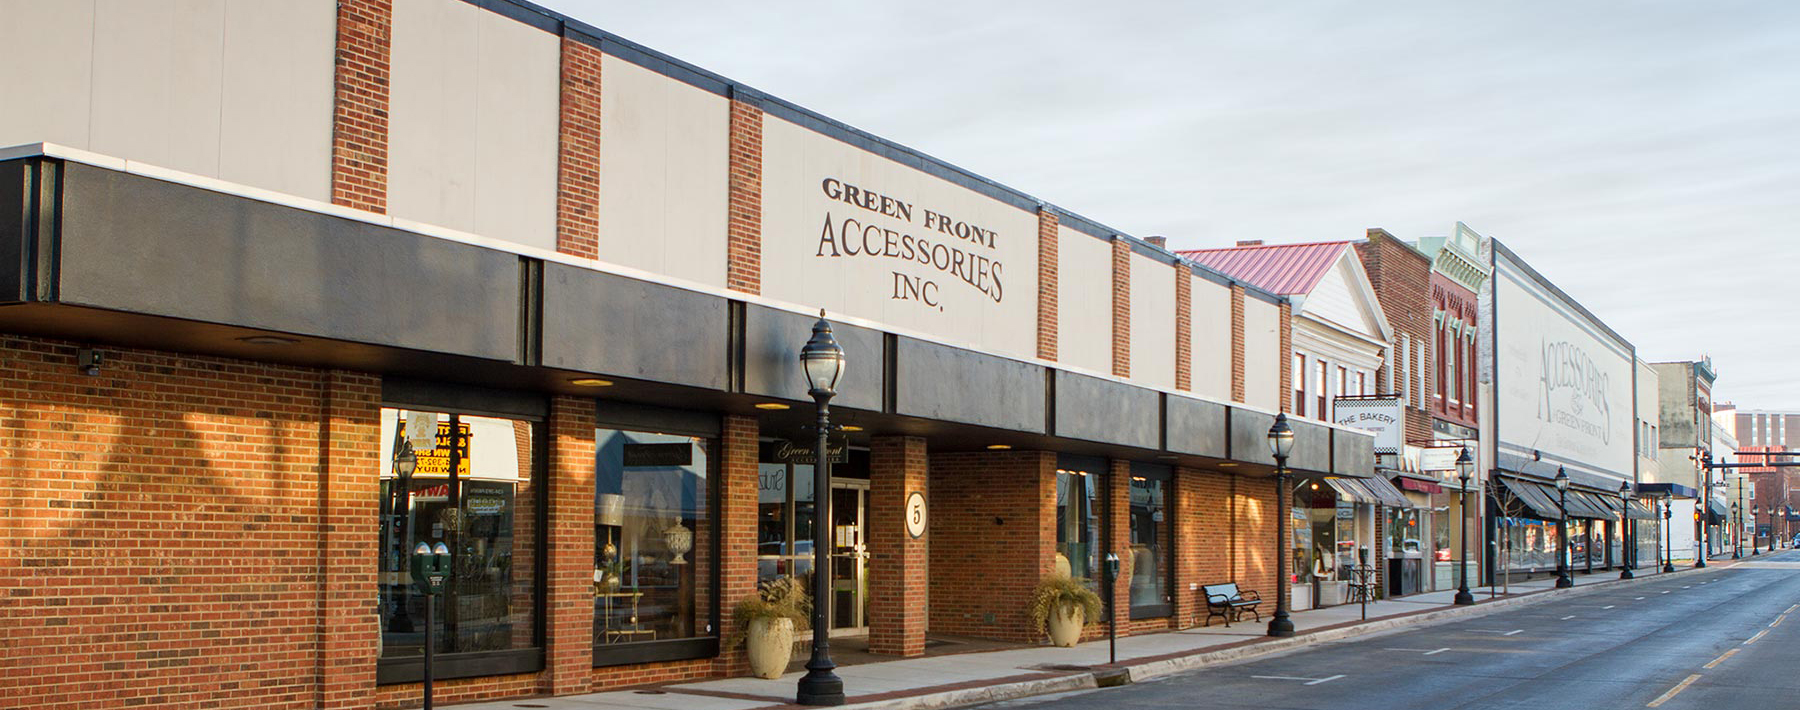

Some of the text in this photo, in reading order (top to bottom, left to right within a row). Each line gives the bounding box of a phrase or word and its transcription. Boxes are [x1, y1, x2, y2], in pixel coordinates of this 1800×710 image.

[822, 177, 999, 249] GREEN FRONT
[816, 210, 1004, 303] ACCESSORIES
[891, 271, 944, 313] INC.
[1537, 335, 1611, 446] ACCESSORIES
[1338, 412, 1396, 426] THE BAKERY
[1555, 408, 1602, 439] GREEN FRONT
[777, 441, 810, 460] Green
[913, 504, 921, 525] 5
